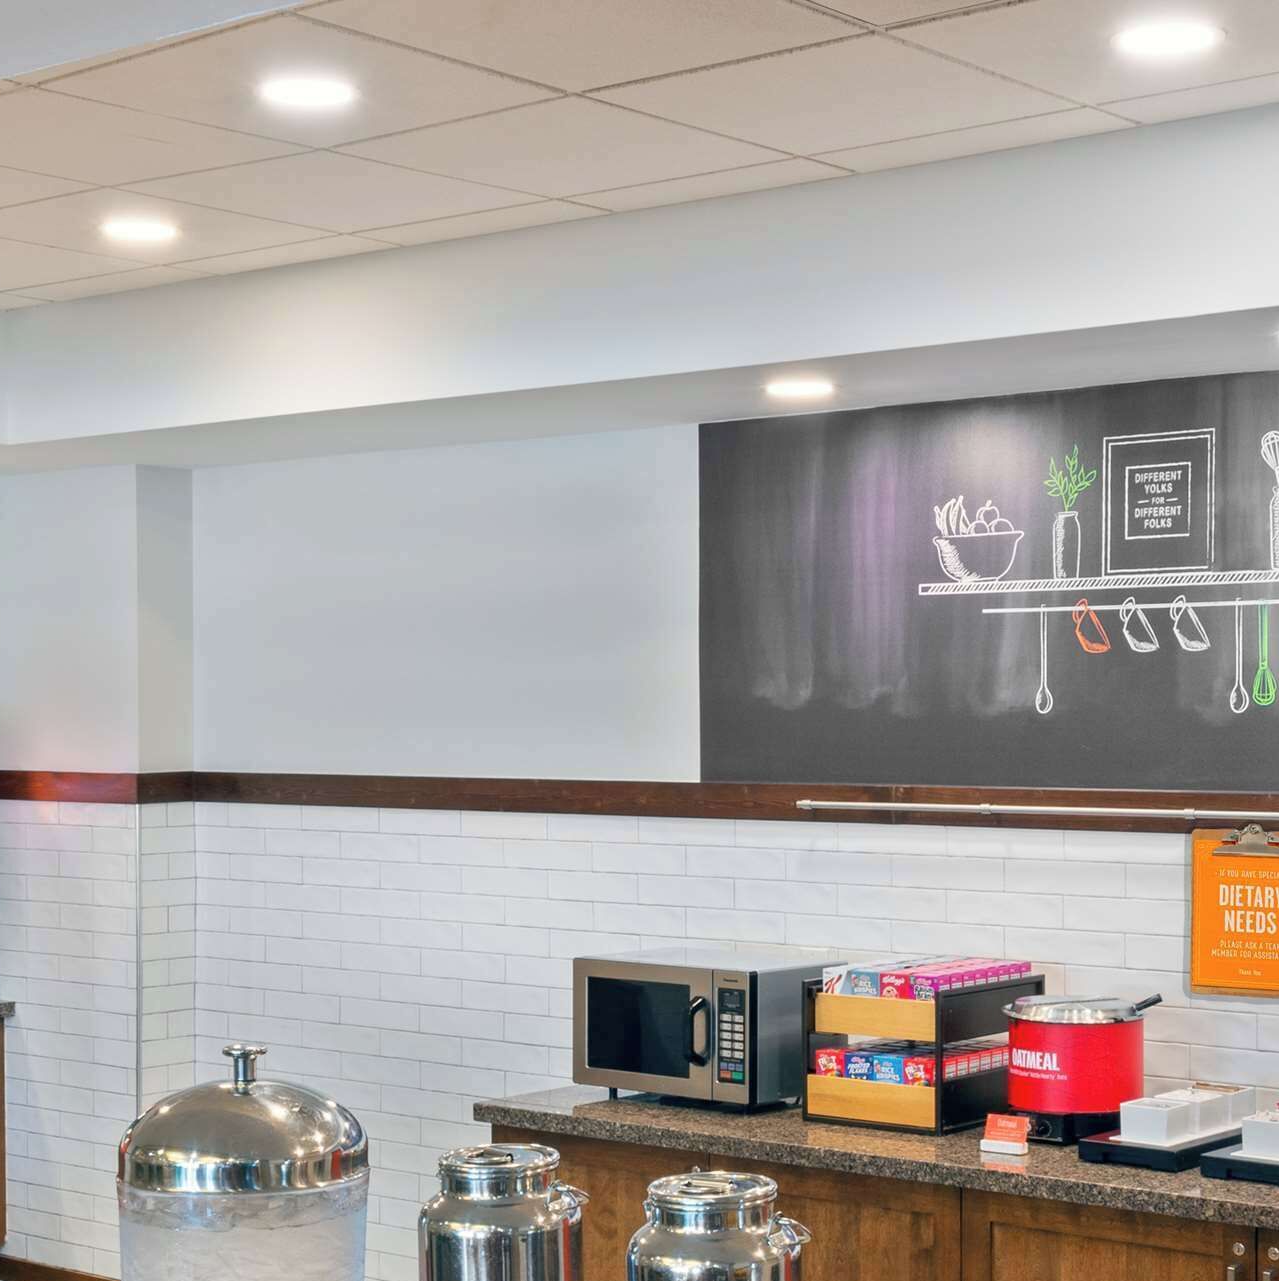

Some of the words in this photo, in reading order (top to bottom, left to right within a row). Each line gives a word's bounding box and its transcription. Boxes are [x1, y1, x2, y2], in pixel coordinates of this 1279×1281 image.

[1134, 470, 1183, 484] DIFFERENT
[1144, 483, 1173, 495] YOLKS
[1151, 496, 1165, 505] FOR
[1134, 505, 1183, 519] DIFFERENT
[1144, 518, 1173, 529] FOLKS
[1224, 909, 1277, 935] NEEDS
[1011, 1047, 1060, 1072] OATMEAL
